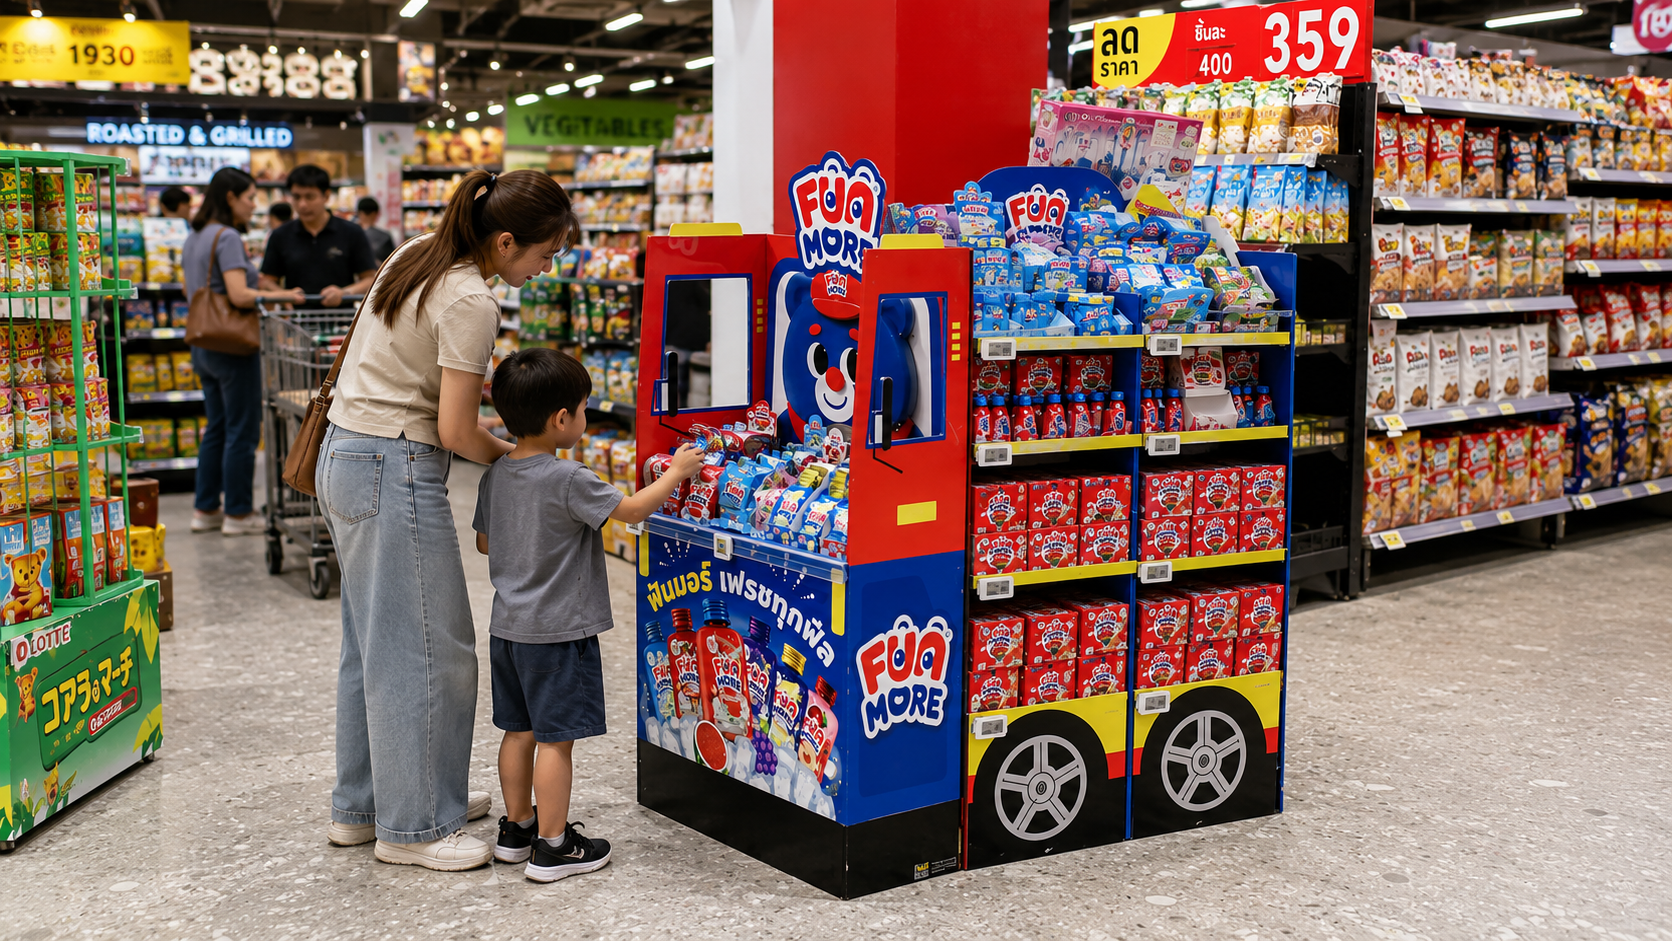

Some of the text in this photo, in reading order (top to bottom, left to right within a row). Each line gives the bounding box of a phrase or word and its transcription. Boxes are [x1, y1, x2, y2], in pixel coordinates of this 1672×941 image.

[1102, 25, 1139, 56] ลด
[1195, 18, 1226, 41] ชิ้นละ
[1264, 6, 1360, 73] 359
[70, 44, 134, 66] 1930
[1100, 60, 1138, 78] ราคา
[1199, 52, 1232, 76] 400
[86, 122, 293, 147] ROASTED & GRILLED
[796, 176, 874, 233] FUN
[1009, 195, 1066, 226] FUN
[30, 624, 70, 656] LOTTE
[860, 631, 946, 695] FUN
[866, 684, 942, 732] MORE
